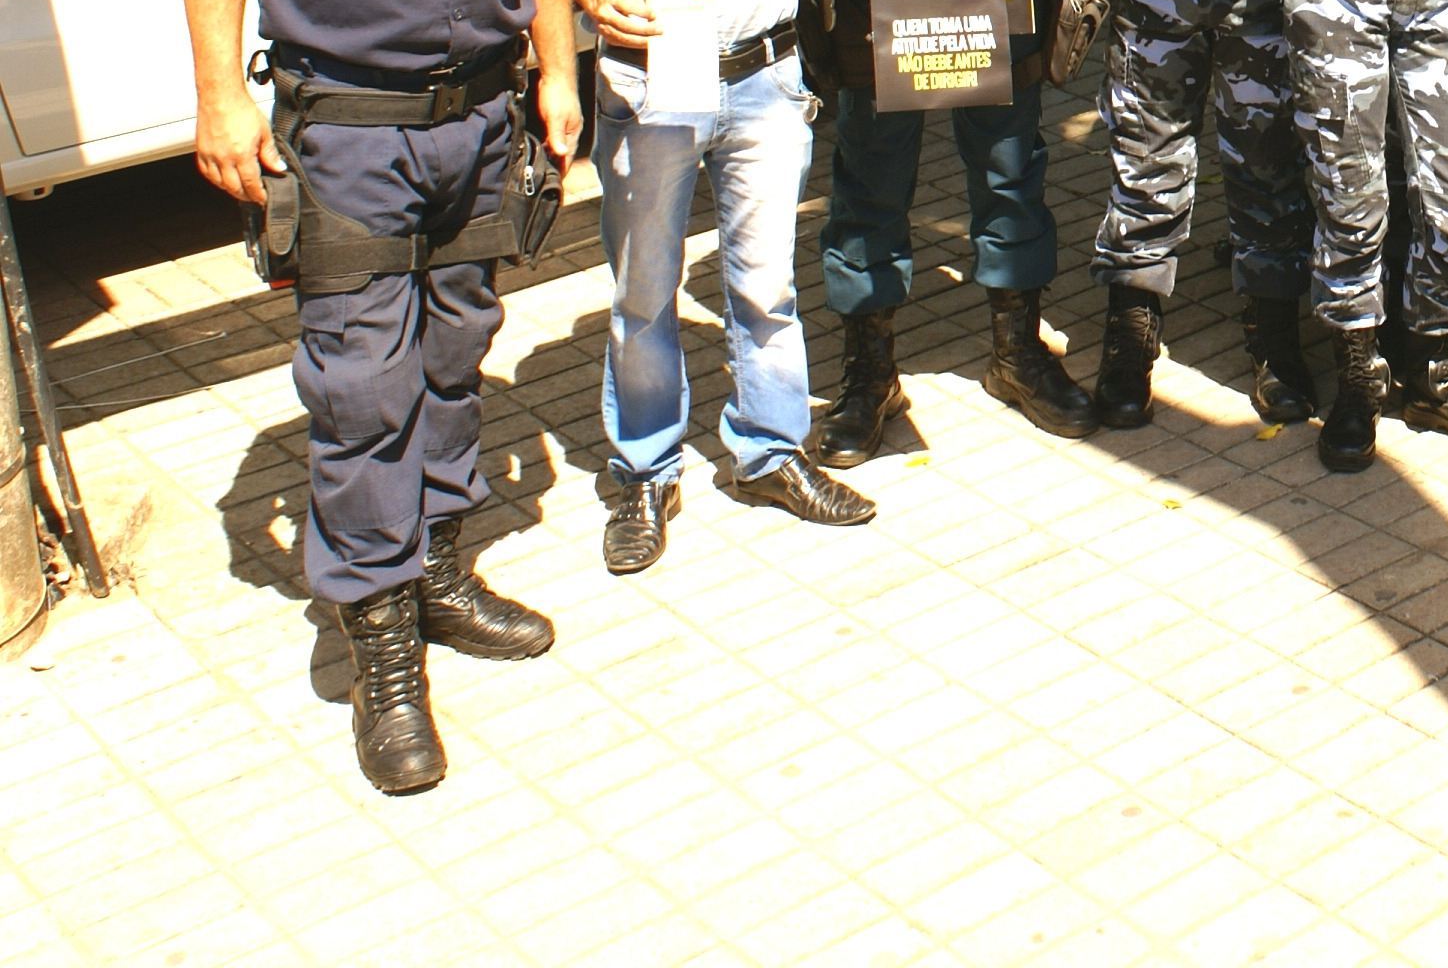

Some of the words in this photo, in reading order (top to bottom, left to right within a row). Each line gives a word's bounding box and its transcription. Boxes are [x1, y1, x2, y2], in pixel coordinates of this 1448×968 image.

[892, 19, 928, 37] QUEM
[928, 17, 963, 34] TOMA
[963, 15, 993, 32] UMA
[939, 35, 968, 52] PELA
[967, 33, 996, 50] VIDA
[898, 52, 922, 72] NÃO
[923, 54, 953, 71] BEBE
[954, 51, 991, 70] ANTES
[914, 73, 930, 90] DE
